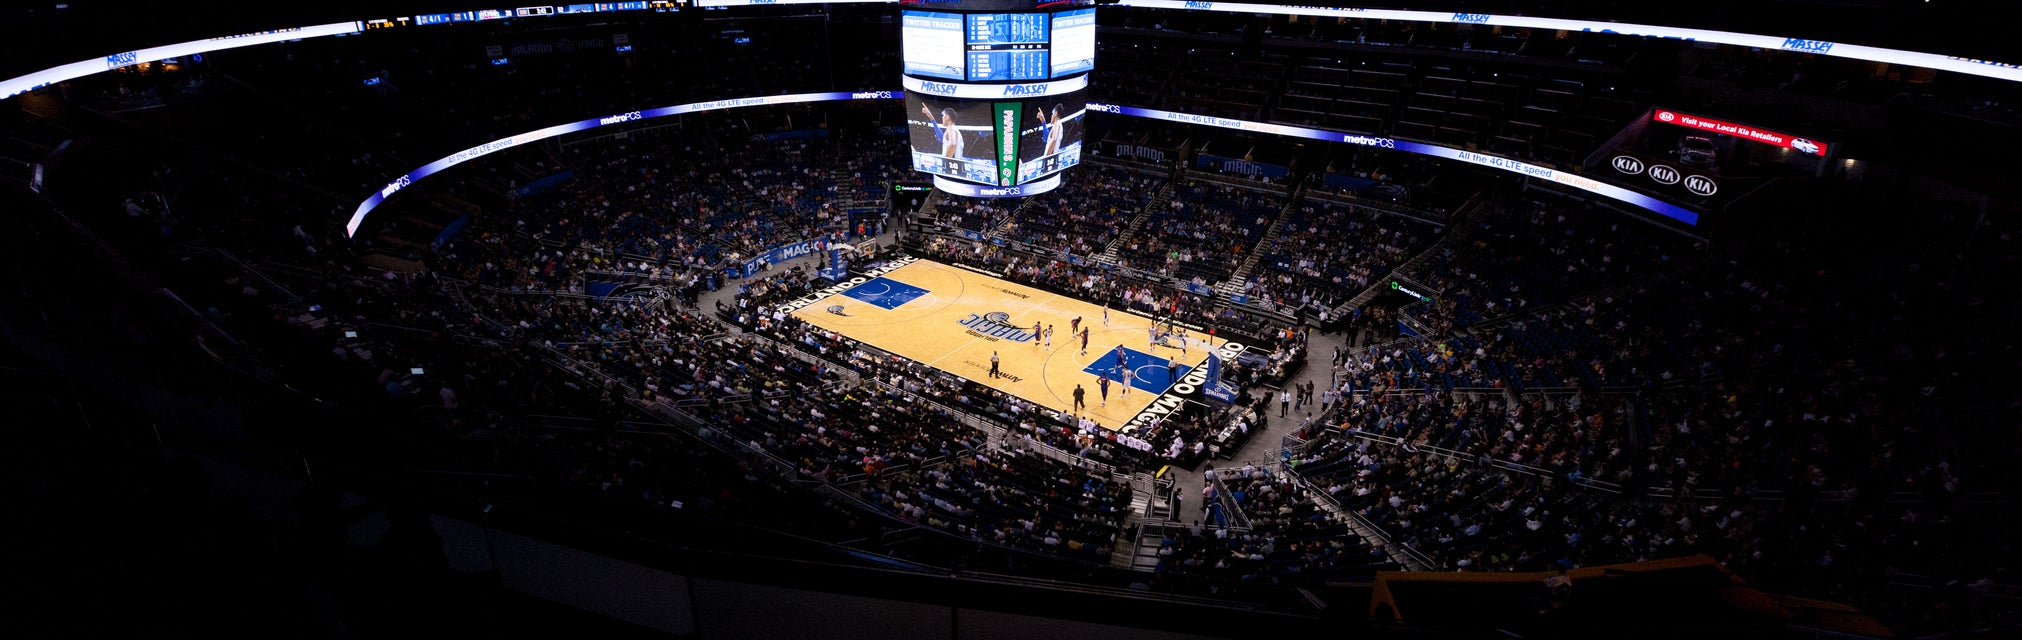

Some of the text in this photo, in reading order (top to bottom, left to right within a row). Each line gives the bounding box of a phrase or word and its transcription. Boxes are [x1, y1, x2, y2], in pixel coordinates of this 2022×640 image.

[1452, 13, 1489, 22] MASSEY
[1782, 38, 1833, 51] MASSEY
[921, 81, 957, 95] MASSEY
[1003, 84, 1048, 95] MASSEY
[742, 98, 764, 106] speed
[1191, 115, 1202, 123] 4G
[1218, 119, 1241, 128] speed
[1681, 116, 1783, 143] Visit your Local Kia Retailers
[1116, 144, 1165, 161] ORLANDO
[1224, 160, 1262, 176] MAGIC
[1458, 151, 1470, 160] All
[1472, 154, 1487, 163] the
[1489, 157, 1503, 167] 4G
[1505, 159, 1521, 170] LTE
[1523, 165, 1552, 178] speed
[1555, 173, 1572, 183] you
[1616, 158, 1711, 193] KIA KIA KIA
[777, 276, 867, 315] ORLANDO
[865, 254, 919, 278] MAGIC
[956, 313, 1036, 343] MAGIC
[1204, 388, 1230, 401] SPALDING
